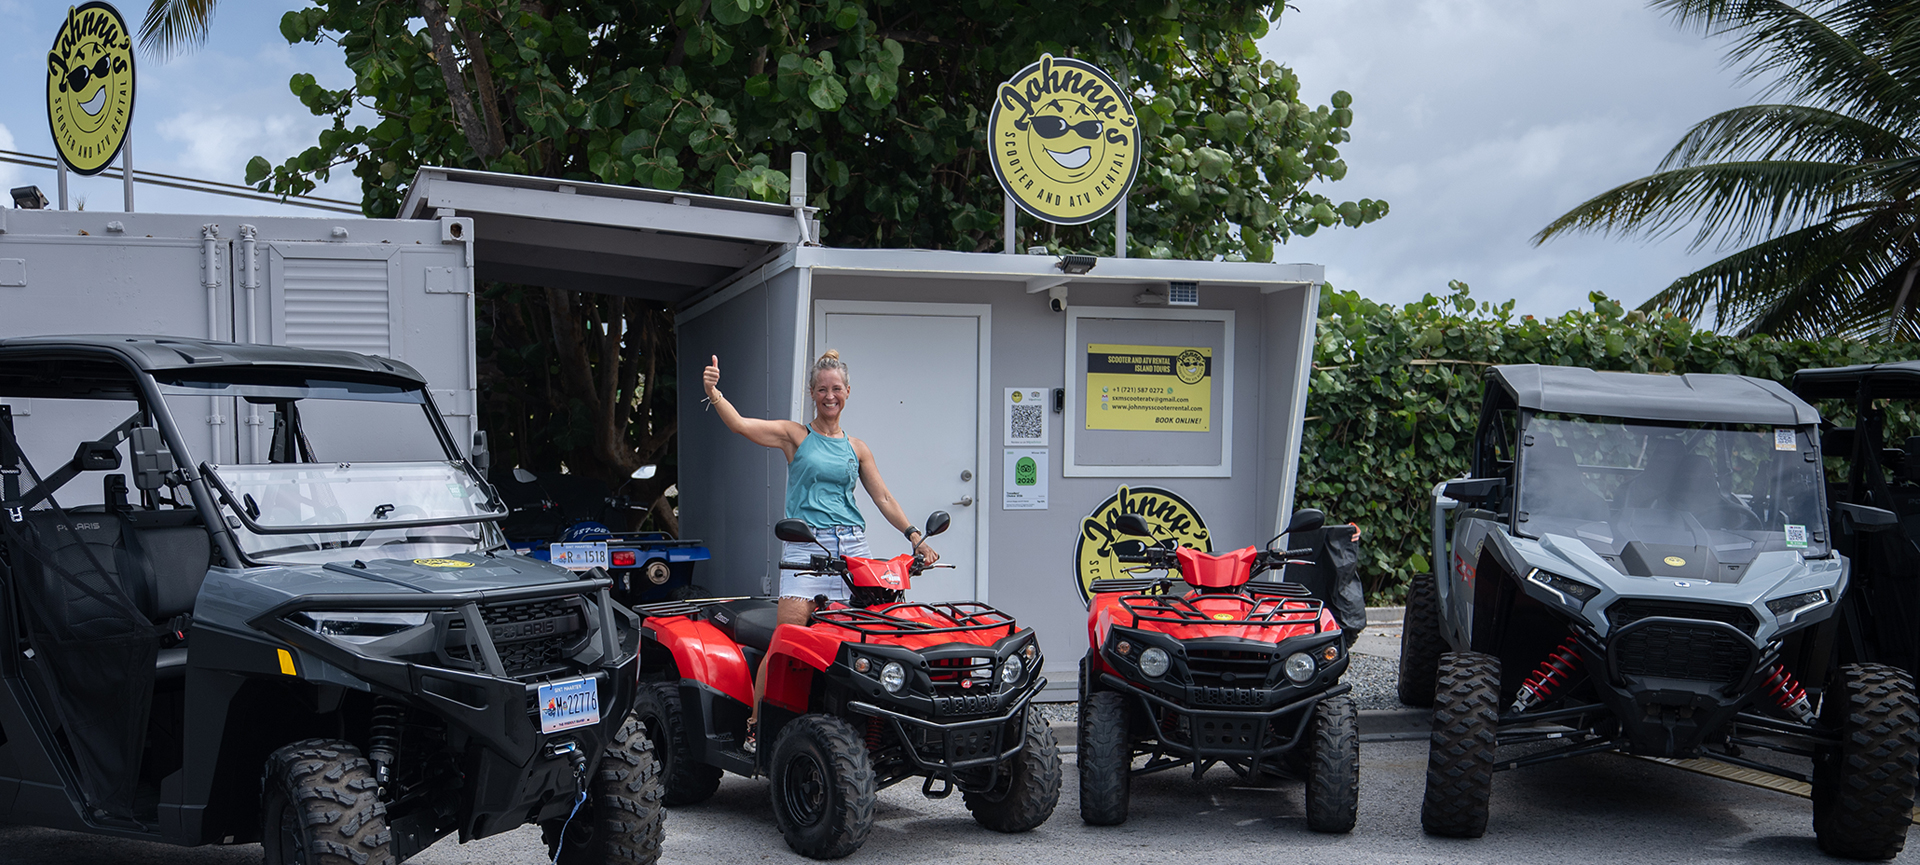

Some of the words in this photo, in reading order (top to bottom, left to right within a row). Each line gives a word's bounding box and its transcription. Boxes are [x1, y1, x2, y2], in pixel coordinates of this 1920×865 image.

[49, 8, 130, 93] Johnny's
[1000, 57, 1136, 146] Johnny's
[54, 97, 74, 152] SCOOTER
[78, 144, 92, 159] AND
[97, 134, 111, 156] ATV
[110, 80, 128, 135] RENTAL
[1004, 131, 1034, 190] SCOOTER
[1036, 188, 1061, 207] AND
[1069, 191, 1091, 208] ATV
[1095, 152, 1126, 196] RENTAL
[1107, 355, 1132, 364] SCOOTER
[1152, 357, 1171, 365] RENTAL
[1154, 365, 1171, 373] TOURS
[1112, 404, 1203, 412] www.johnnysscooterrental.com
[567, 551, 573, 563] R
[584, 551, 605, 563] 1518
[556, 696, 563, 717] M
[568, 691, 597, 715] 22776
